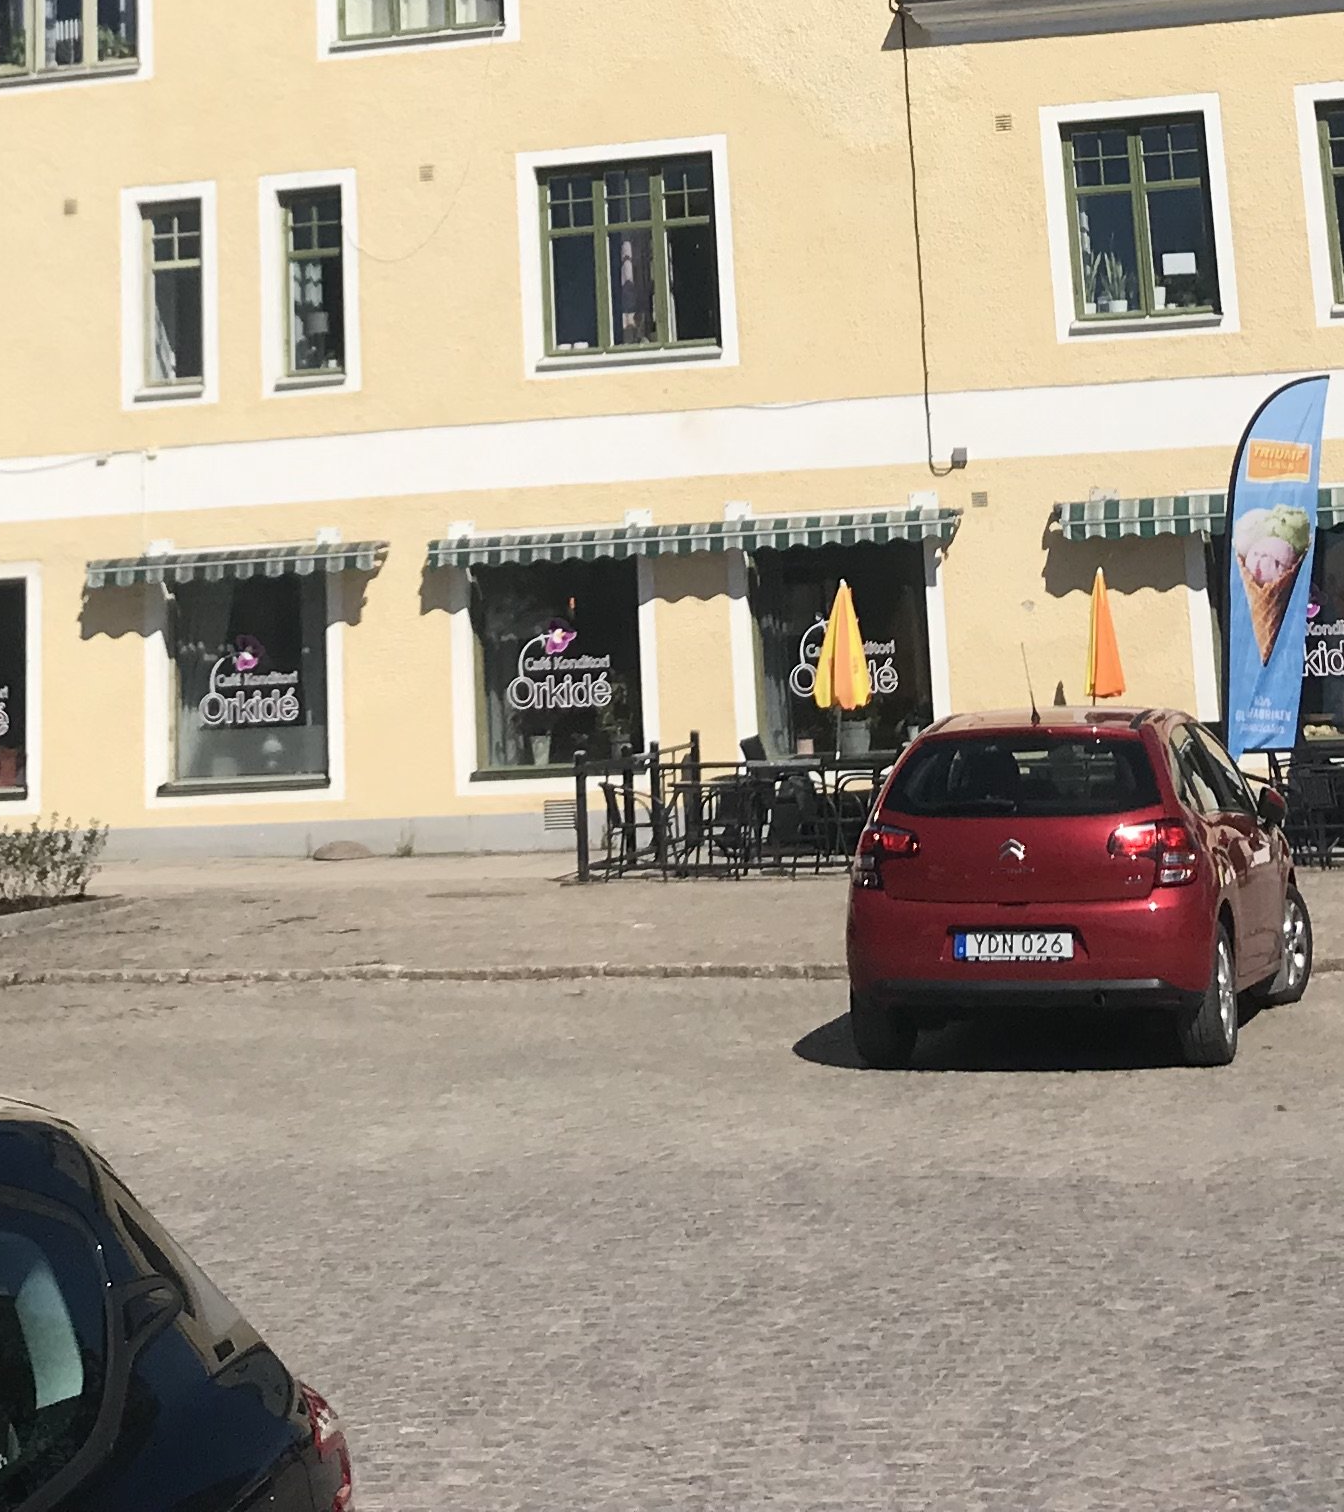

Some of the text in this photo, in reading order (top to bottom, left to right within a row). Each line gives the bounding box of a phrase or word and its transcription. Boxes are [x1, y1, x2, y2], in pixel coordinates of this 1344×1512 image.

[198, 687, 300, 725] Orkidé
[507, 671, 612, 710] Orkidé
[974, 933, 1063, 954] YDN 026
